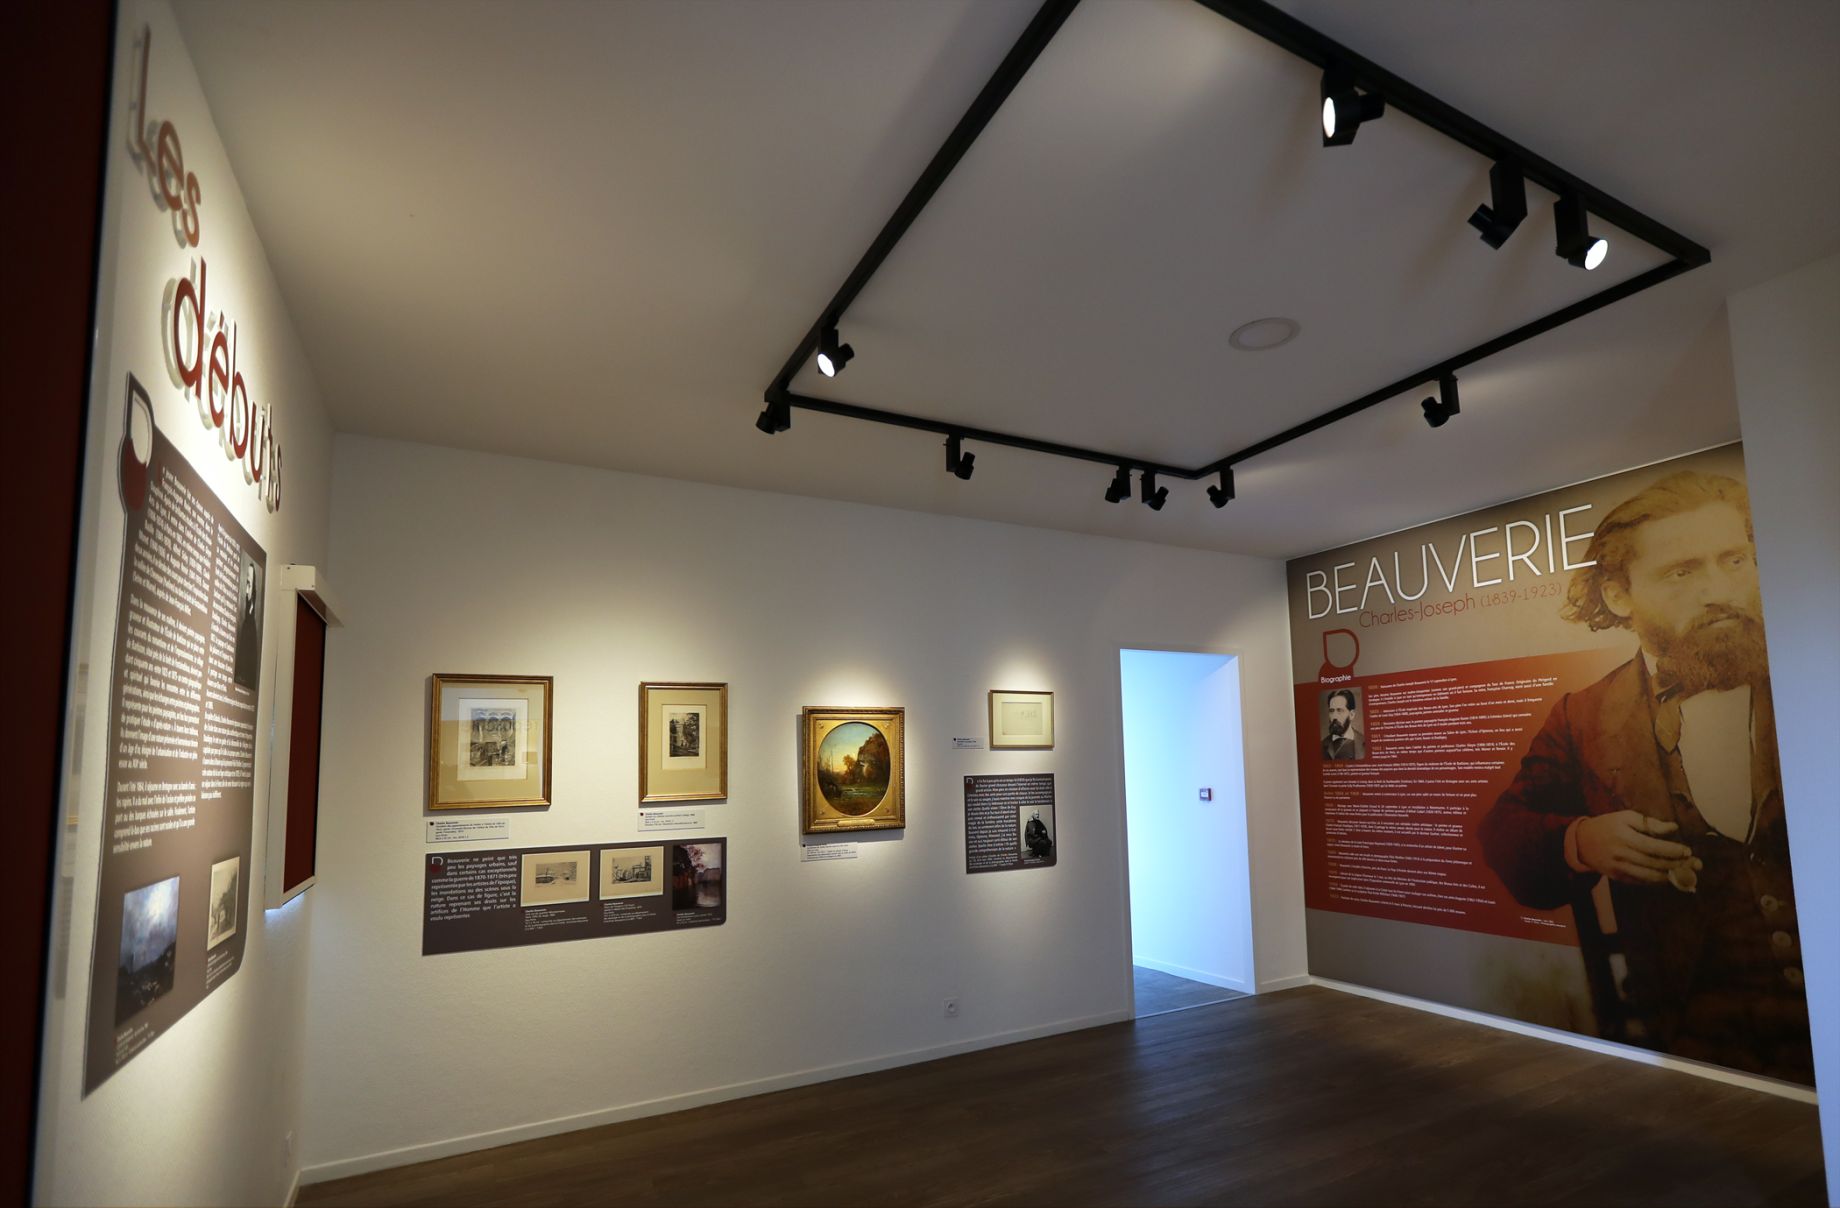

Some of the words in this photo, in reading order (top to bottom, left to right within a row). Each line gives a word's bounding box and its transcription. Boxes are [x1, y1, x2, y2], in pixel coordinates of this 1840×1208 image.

[134, 24, 201, 248] Les
[174, 256, 283, 512] débuts
[1306, 504, 1597, 620] BEAUVERIE
[1359, 593, 1476, 629] Charles-Joseph
[1480, 582, 1562, 609] (1839-1923)
[1320, 674, 1352, 685] Biographie
